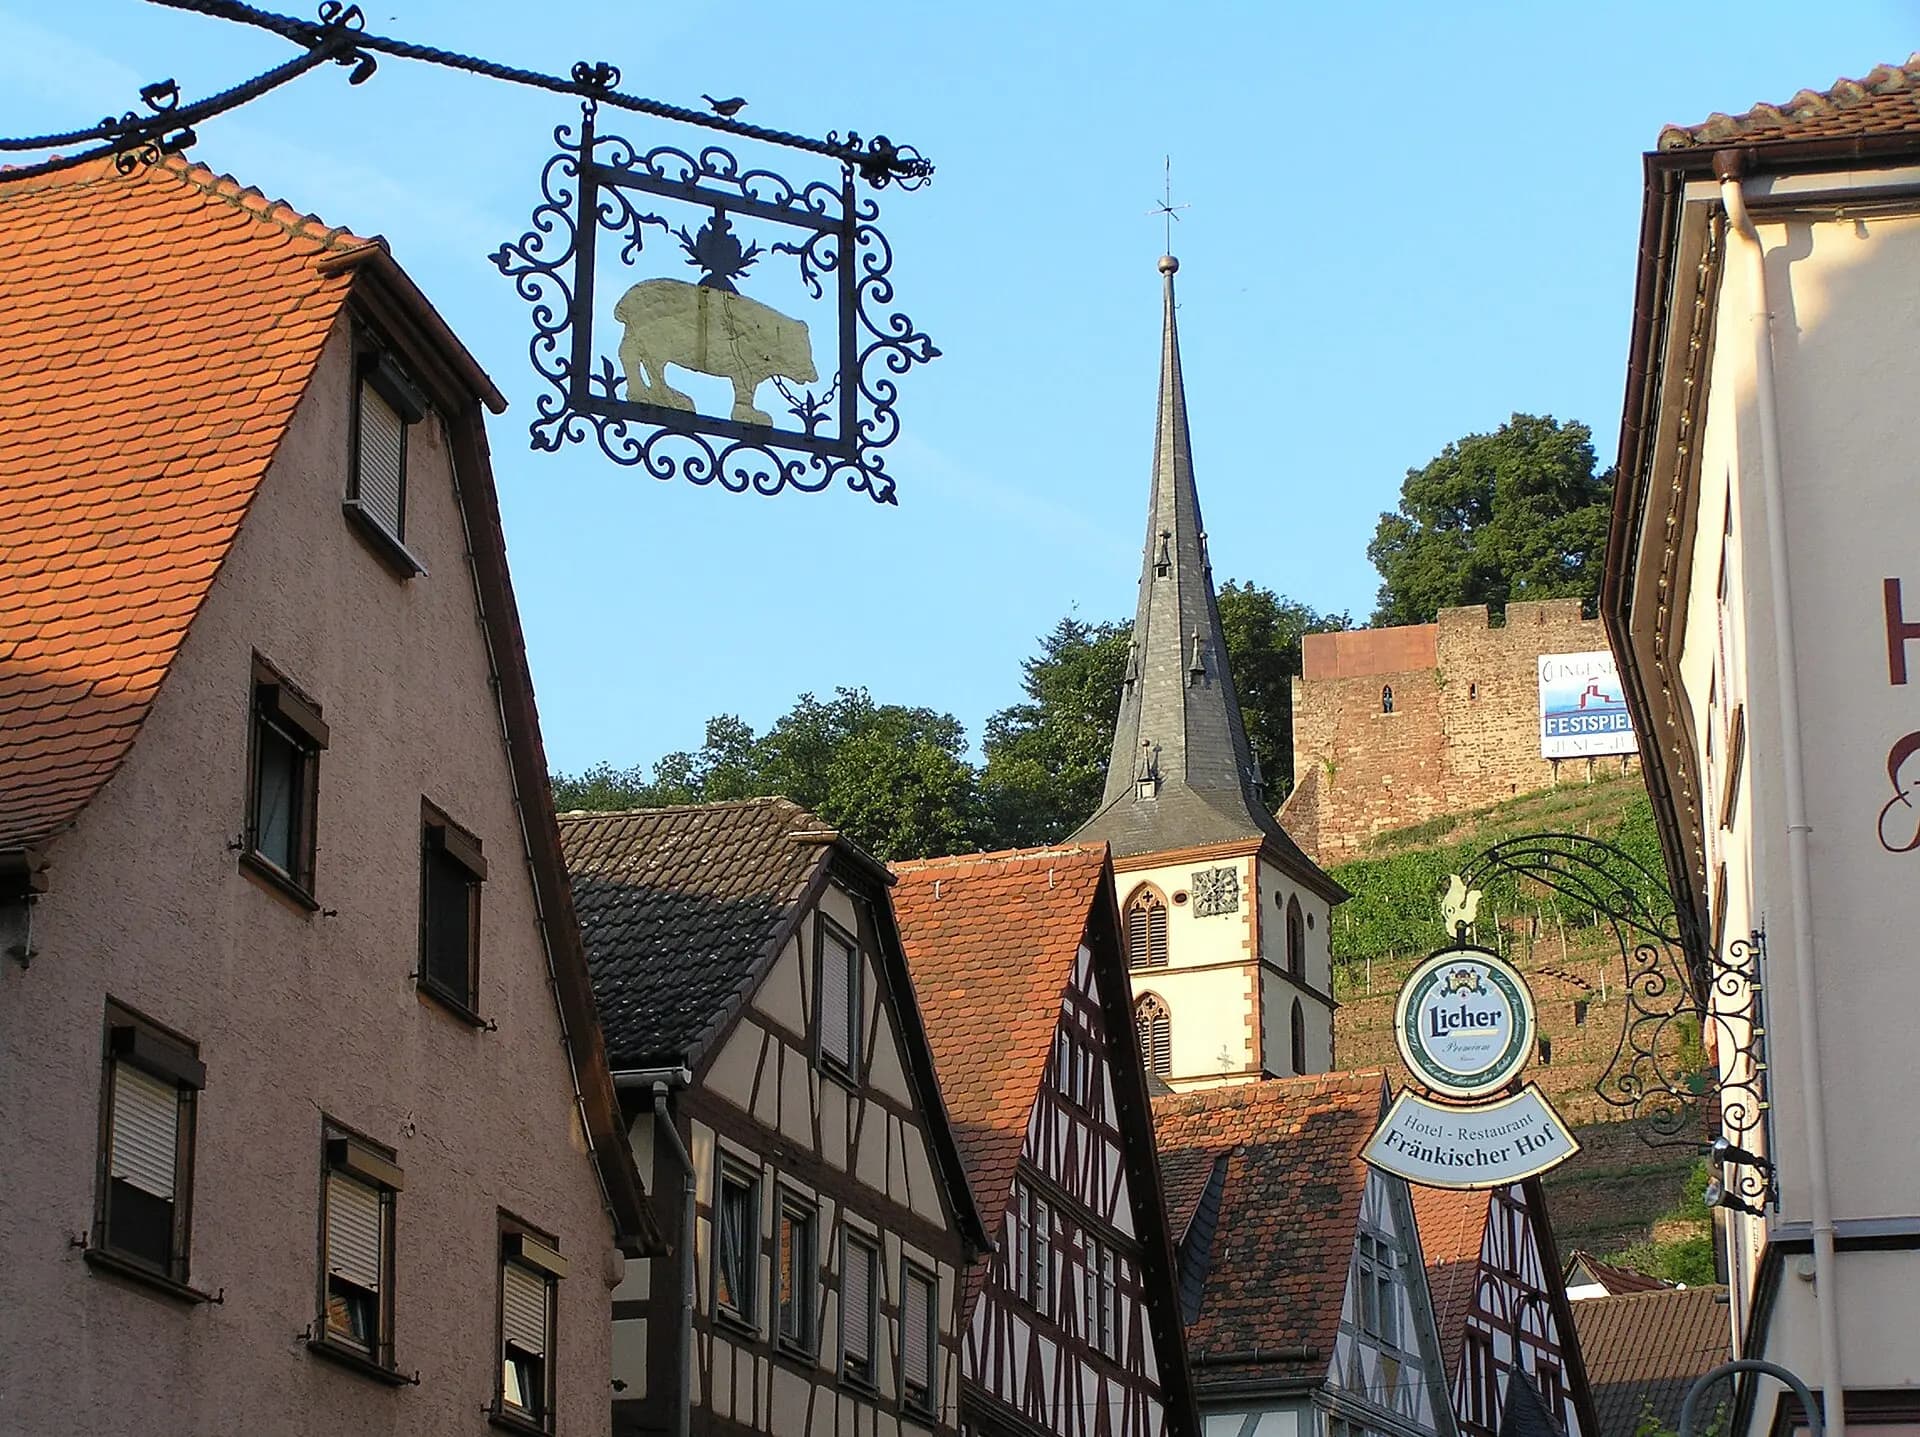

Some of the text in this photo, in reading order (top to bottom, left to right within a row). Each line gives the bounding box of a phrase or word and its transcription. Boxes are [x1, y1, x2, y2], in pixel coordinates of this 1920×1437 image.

[1429, 1004, 1502, 1037] Licher
[1404, 1115, 1443, 1138] Hotel
[1458, 1113, 1534, 1141] Restaurant
[1383, 1122, 1555, 1167] Fränkischer Hof
